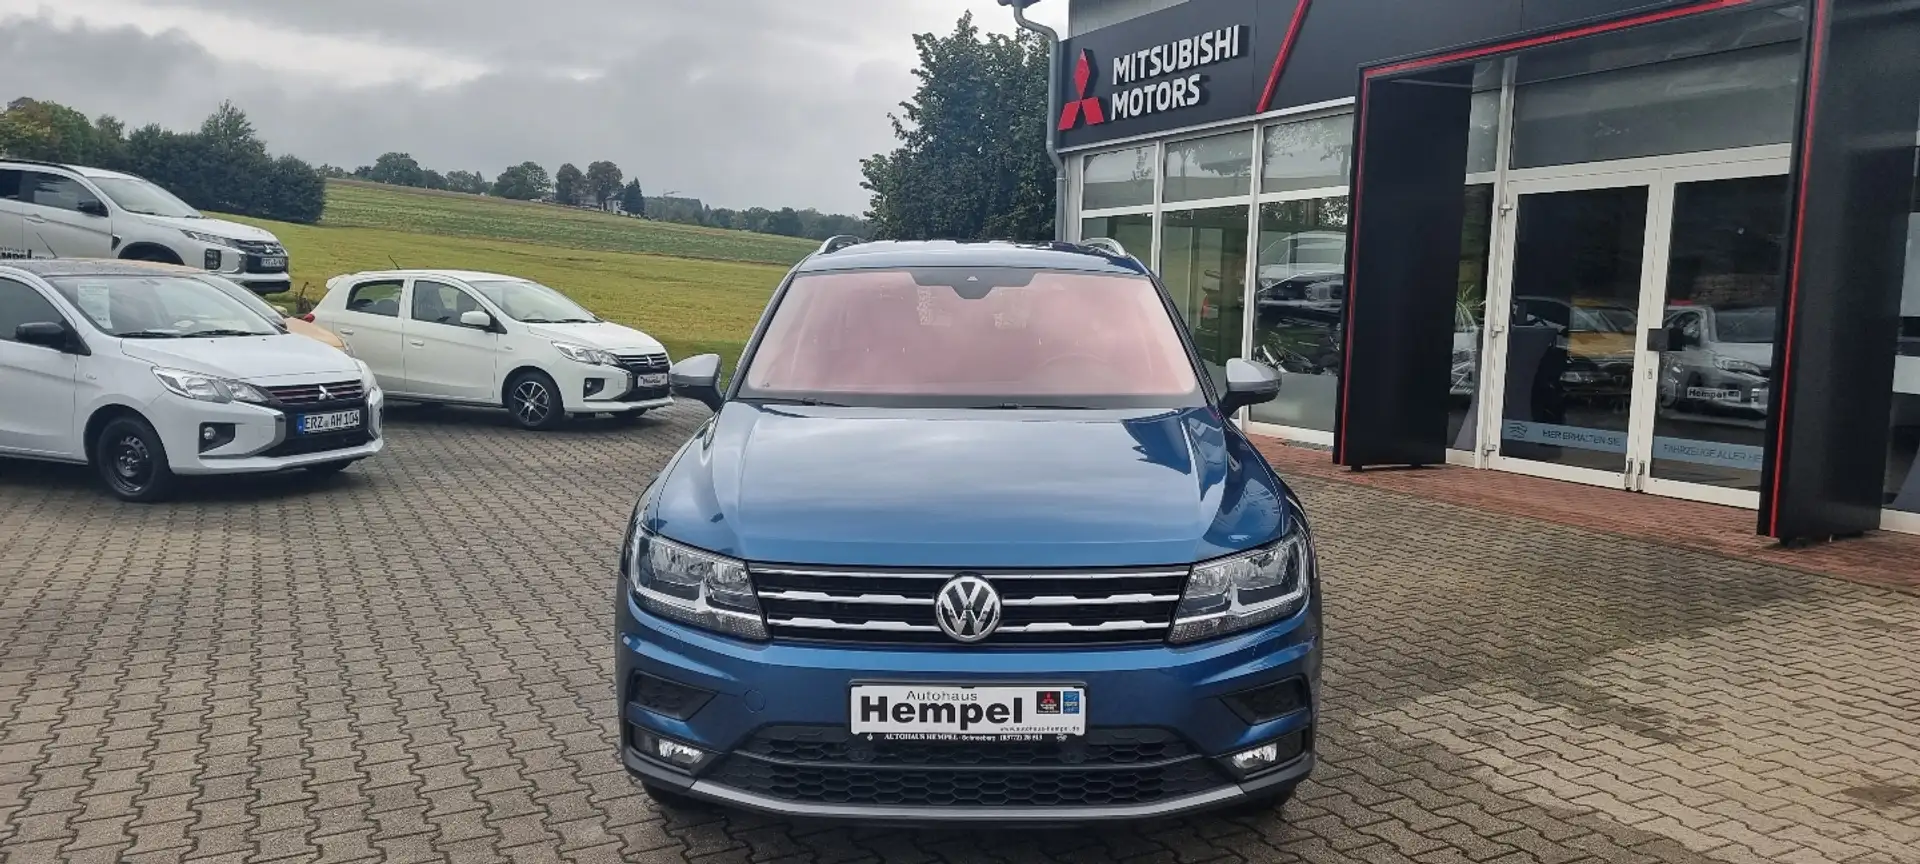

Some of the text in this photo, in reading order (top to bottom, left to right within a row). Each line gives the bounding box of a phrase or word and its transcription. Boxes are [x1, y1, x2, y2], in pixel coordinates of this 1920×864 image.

[1112, 24, 1239, 85] MITSUBISHI
[1111, 73, 1201, 121] MOTORS
[305, 411, 359, 429] ERZ AH 104
[936, 576, 1001, 641] VW
[860, 695, 1023, 731] Hempel
[906, 690, 978, 701] Autohaus
